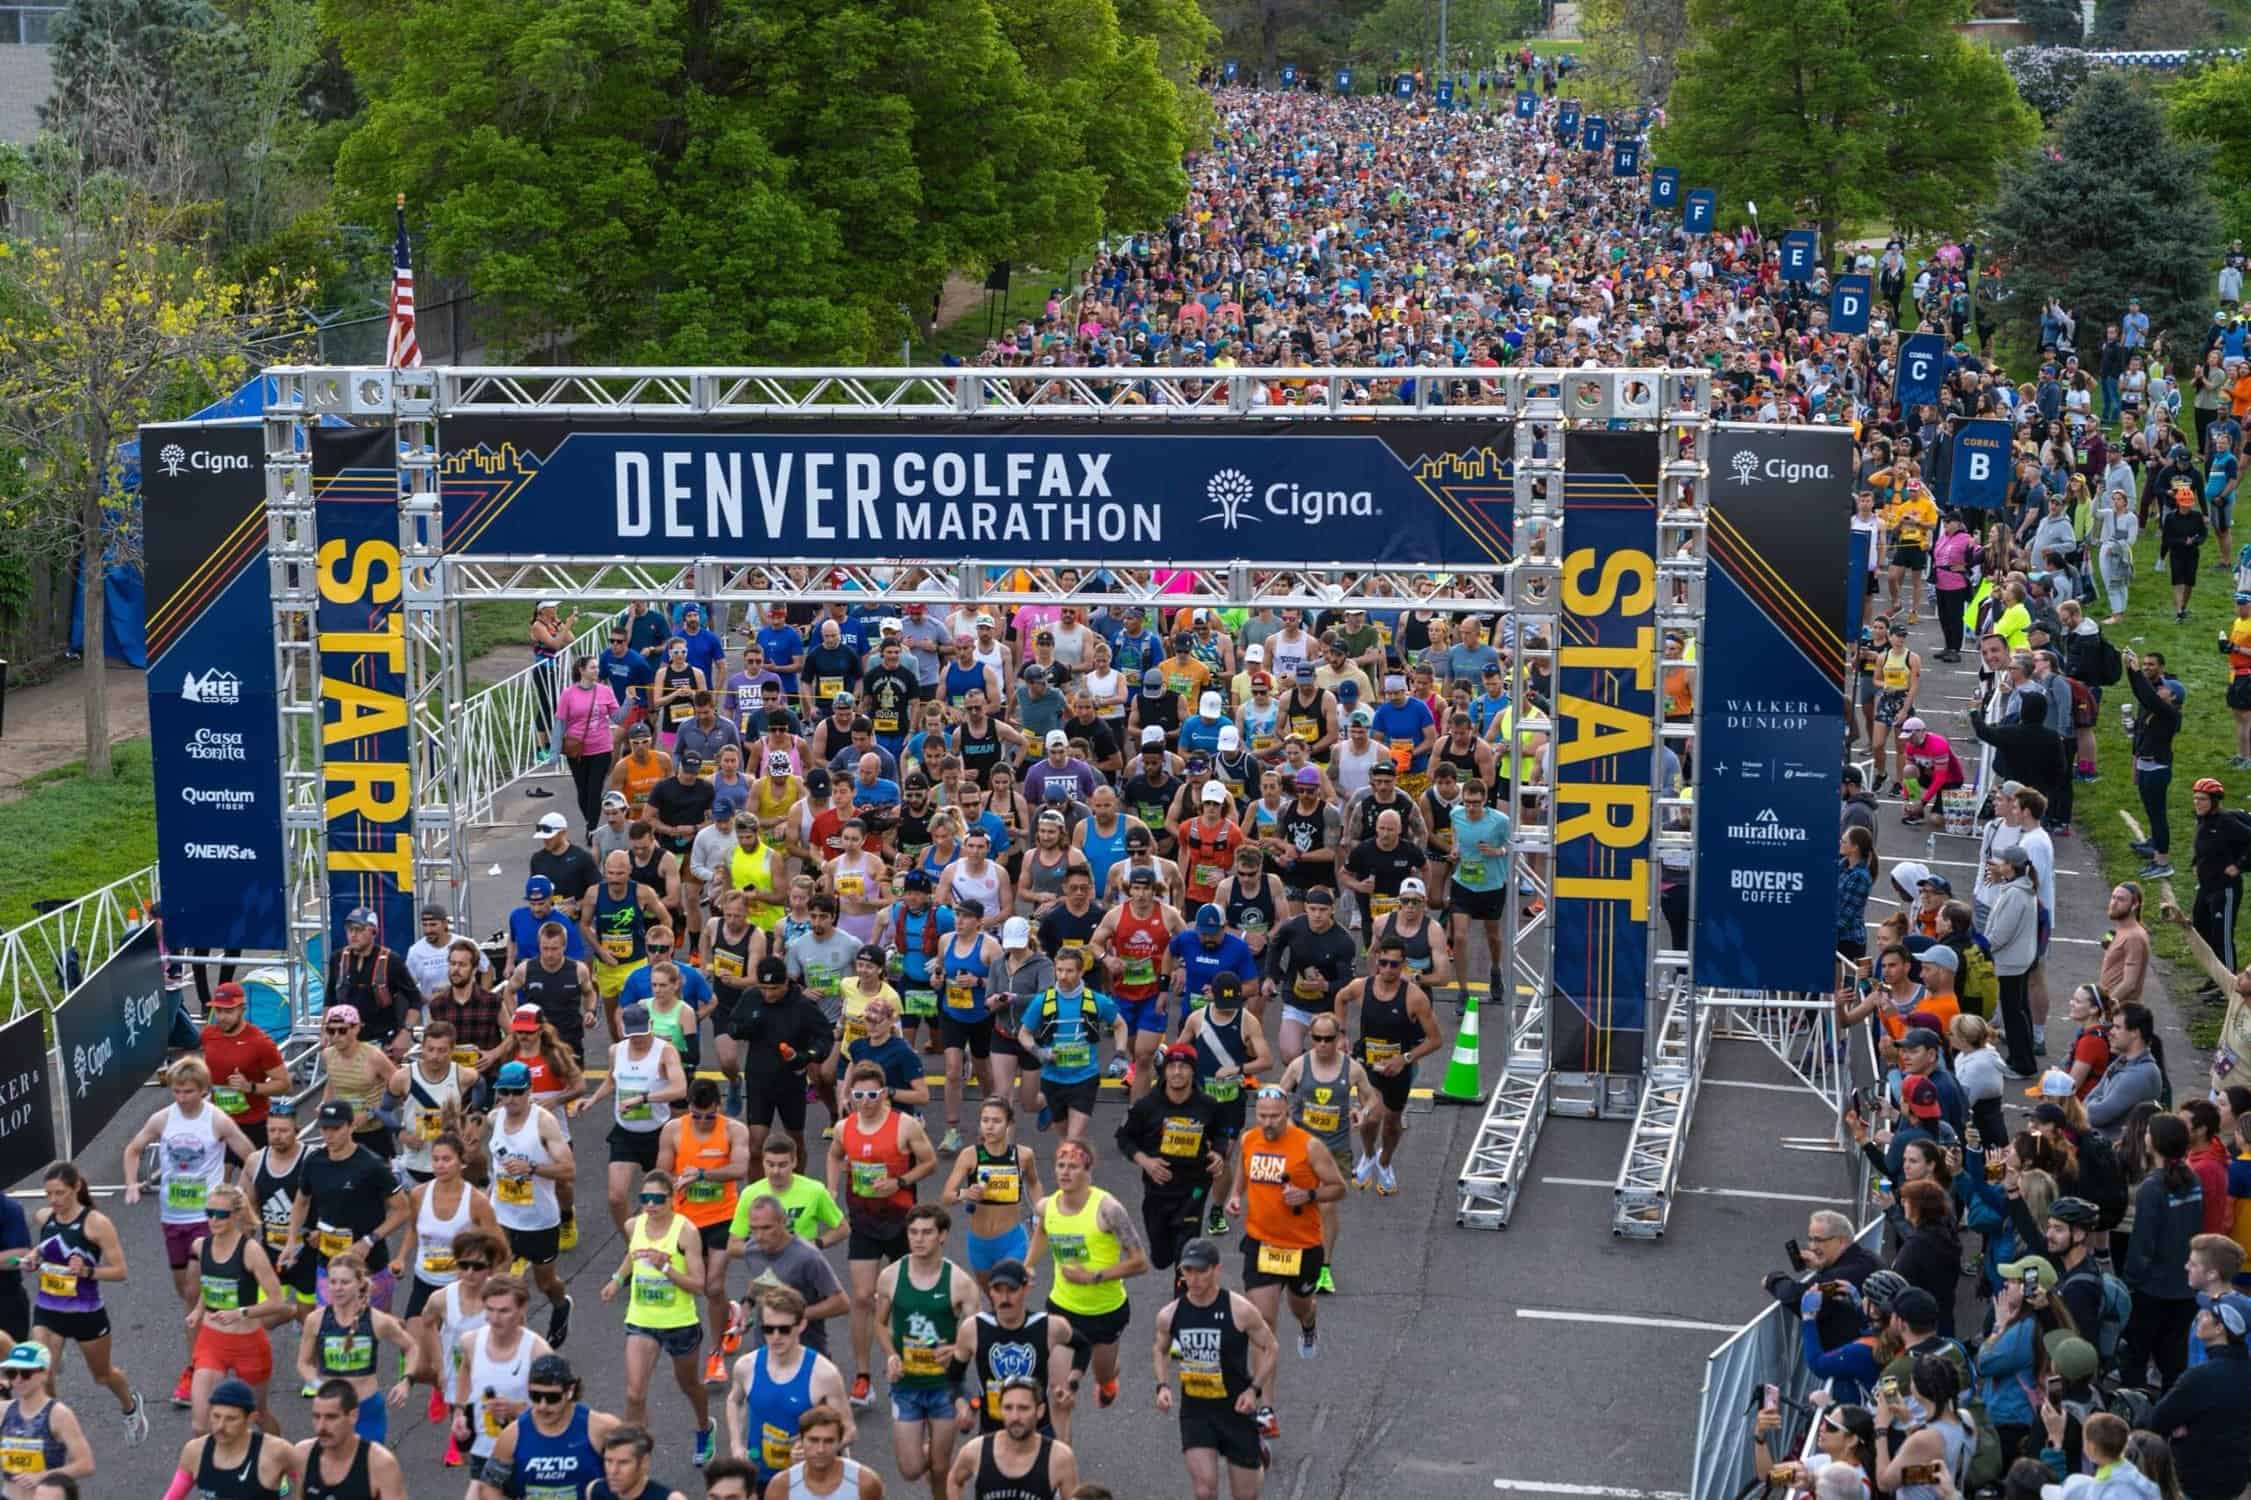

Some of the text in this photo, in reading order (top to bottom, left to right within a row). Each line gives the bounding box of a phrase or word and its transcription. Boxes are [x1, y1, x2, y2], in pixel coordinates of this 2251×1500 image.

[1441, 91, 1448, 100] L
[1522, 101, 1530, 111] K
[1565, 113, 1573, 125] J
[1621, 154, 1632, 167] H
[1659, 181, 1671, 196] G
[1693, 206, 1705, 221] F
[1791, 249, 1804, 267] E
[1842, 296, 1858, 316] D
[1908, 350, 1933, 360] CORRAL
[1912, 360, 1927, 380] C
[1963, 437, 2001, 449] CORRAL
[190, 451, 249, 474] Cigna
[1765, 458, 1829, 484] Cigna
[1969, 452, 1990, 481] B
[893, 452, 1113, 498] COLFAX
[614, 451, 881, 539] DENVER
[1264, 482, 1374, 524] Cigna
[895, 501, 1161, 542] MARATHON
[201, 681, 240, 696] REI
[317, 537, 415, 893] START
[1727, 699, 1809, 714] WALKER
[1727, 716, 1809, 730] DUNLOP
[195, 728, 243, 744] Casa
[1554, 548, 1656, 923] START
[185, 742, 246, 760] Bonita
[182, 787, 255, 805] Quantum
[1727, 822, 1807, 841] miraflora
[184, 843, 240, 859] 9NEWS
[1731, 869, 1804, 891] BOYER'S
[1742, 890, 1794, 904] COFFEE
[137, 989, 160, 1028] Cigna
[88, 1036, 112, 1077] Cigna
[1251, 1154, 1287, 1172] RUN
[1180, 1333, 1221, 1350] RUN
